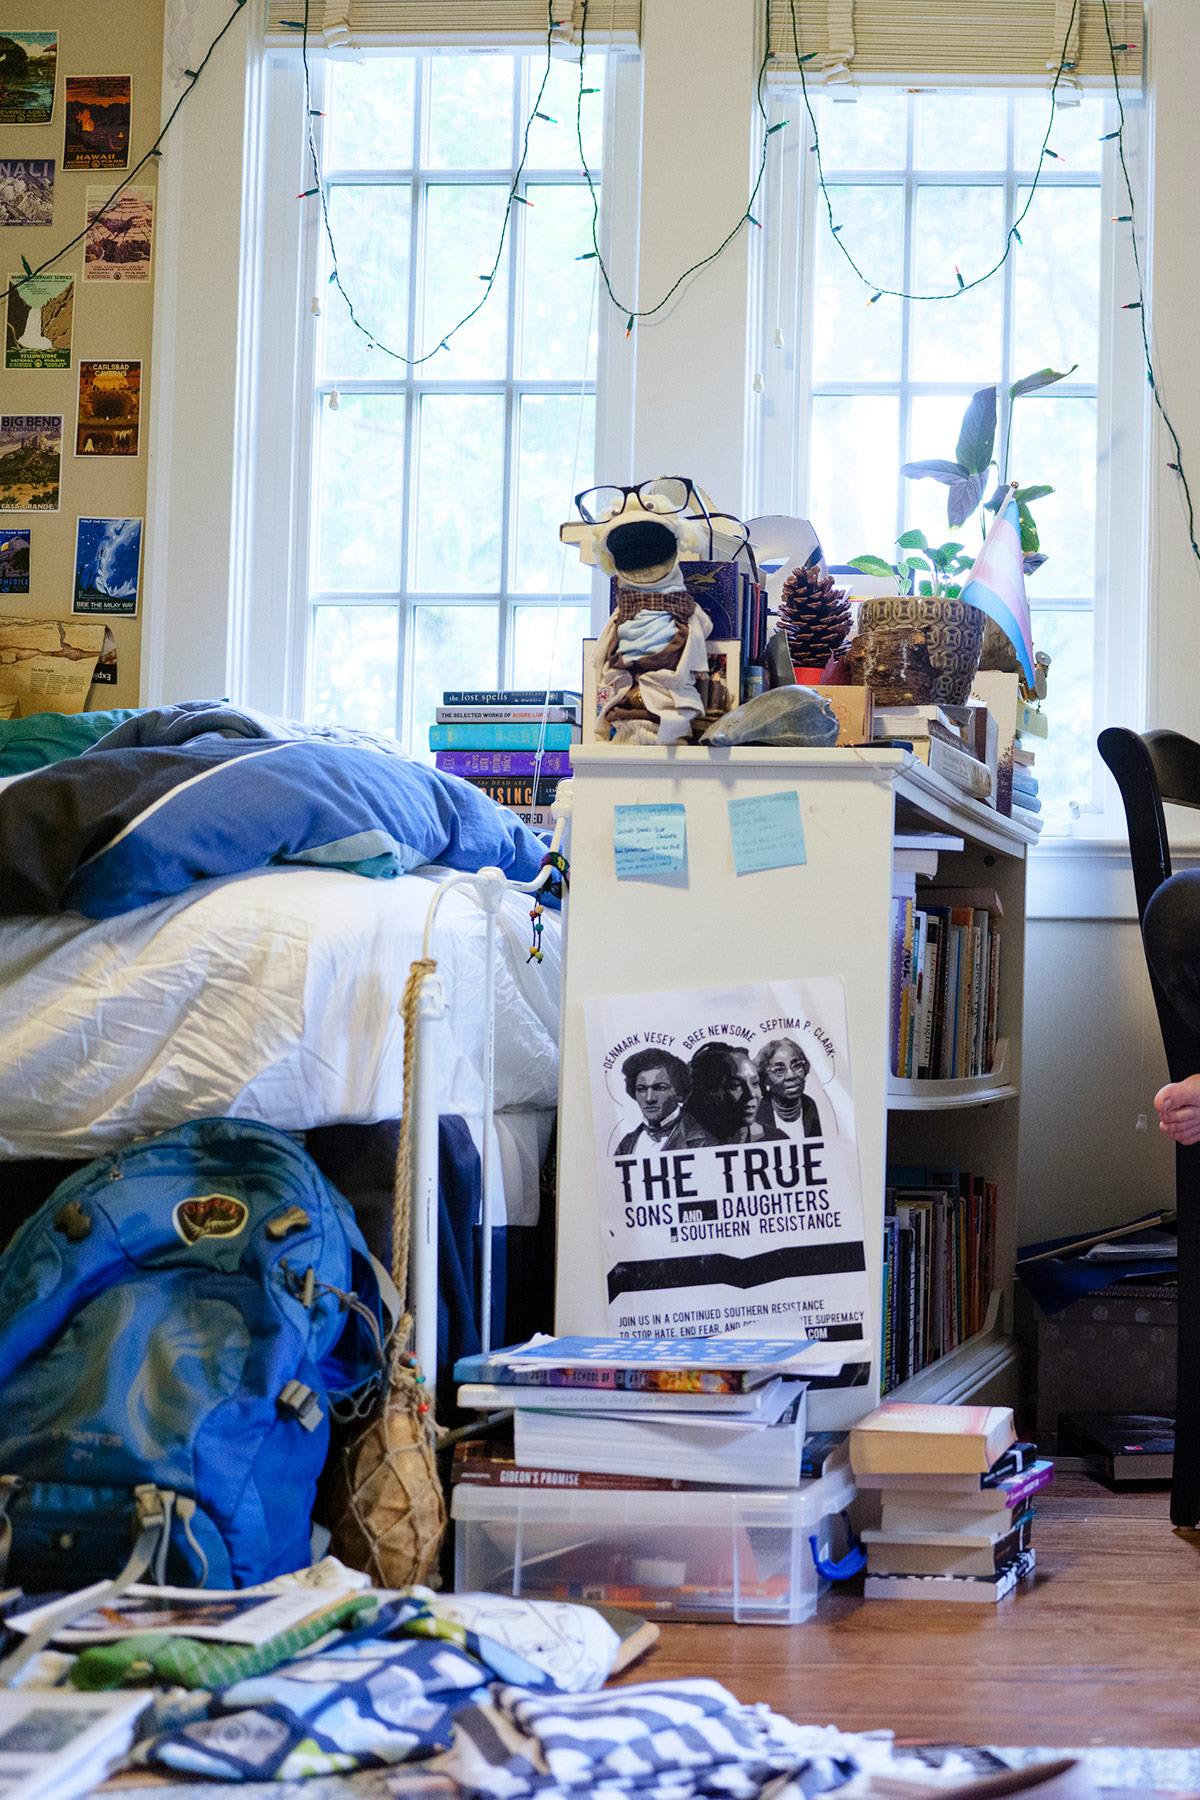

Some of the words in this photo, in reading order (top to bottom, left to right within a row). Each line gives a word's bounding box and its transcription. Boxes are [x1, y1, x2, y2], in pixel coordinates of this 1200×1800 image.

[1, 416, 26, 427] BIG
[26, 416, 61, 427] BEND
[1, 425, 38, 433] NATIONAL
[461, 692, 478, 701] lost
[481, 691, 508, 704] spells
[603, 1034, 642, 1070] DENMARK
[644, 1031, 677, 1048] VESEY
[682, 1027, 705, 1051] BREE
[707, 1023, 757, 1043] NEWSOME
[759, 1017, 801, 1034] SEPTIMA
[803, 1020, 812, 1034] P.
[813, 1028, 836, 1057] CLARK
[922, 1010, 933, 1059] English
[614, 1153, 698, 1203] THE
[715, 1142, 828, 1194] TRUE
[624, 1203, 674, 1228] SONS
[682, 1208, 703, 1223] AND
[722, 1188, 830, 1220] DAUGHTERS
[680, 1220, 750, 1242] SOUTHERN
[759, 1211, 842, 1234] RESISTANCE
[618, 1315, 637, 1328] JOIN
[638, 1314, 650, 1326] US
[652, 1313, 662, 1325] IN
[664, 1312, 671, 1324] A
[672, 1308, 722, 1323] CONTINUED
[723, 1304, 769, 1319] SOUTHERN
[771, 1299, 825, 1315] RESISTANCE
[619, 1328, 630, 1339] TO
[631, 1326, 653, 1339] STOP
[654, 1326, 679, 1339] HATE,
[680, 1325, 697, 1337] END
[698, 1323, 722, 1336] FEAR,
[814, 1310, 865, 1326] SUPREMACY
[807, 1327, 828, 1339] COM
[601, 1372, 611, 1382] OF
[500, 1469, 540, 1485] GIDEON'S
[540, 1470, 580, 1487] PROMISE
